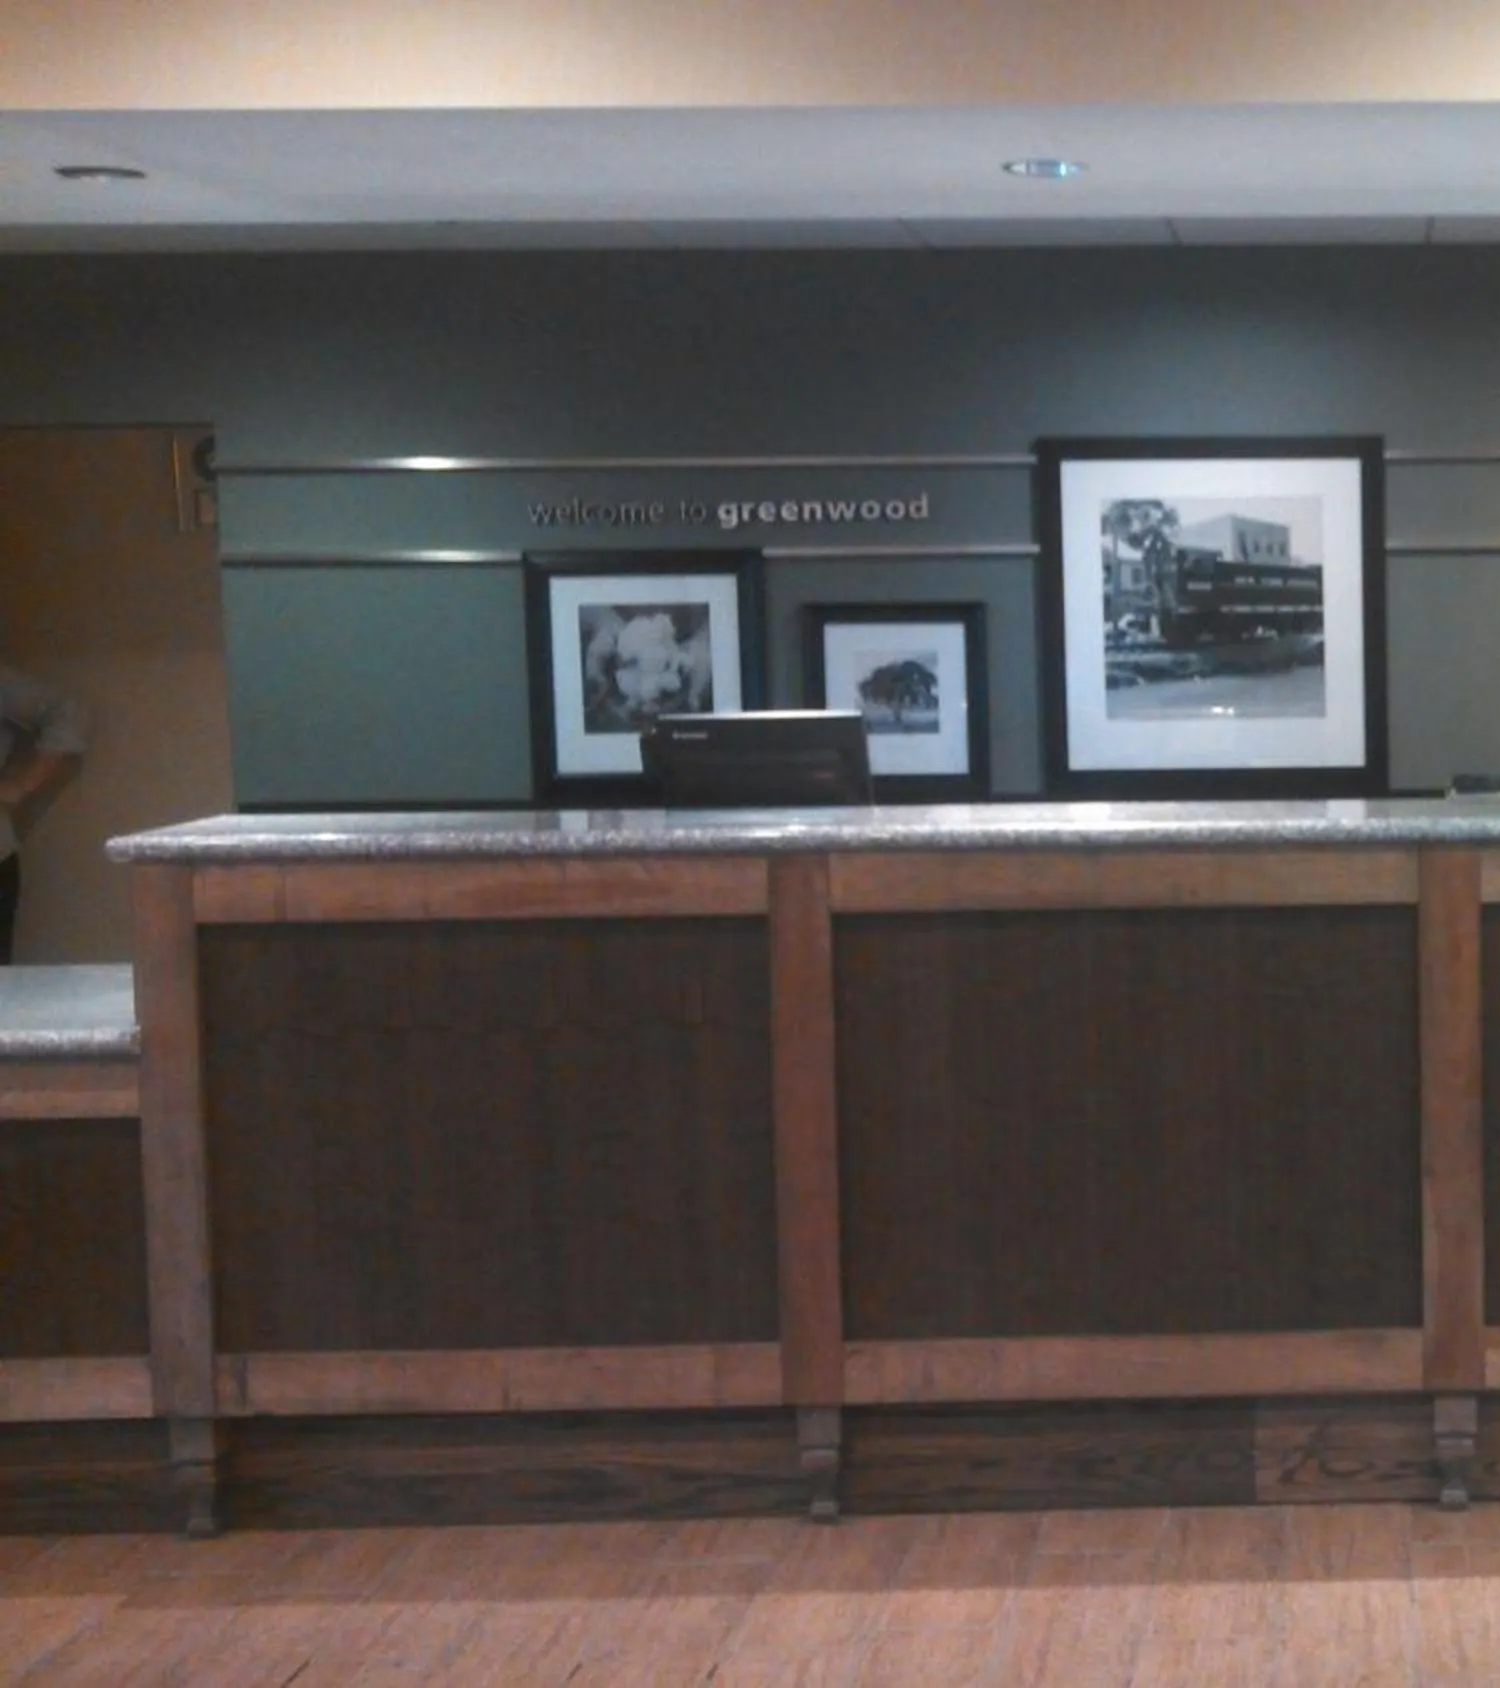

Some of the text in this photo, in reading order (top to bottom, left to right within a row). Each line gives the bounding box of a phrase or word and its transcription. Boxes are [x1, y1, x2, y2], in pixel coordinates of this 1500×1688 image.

[527, 492, 929, 530] welcome to greenwood
